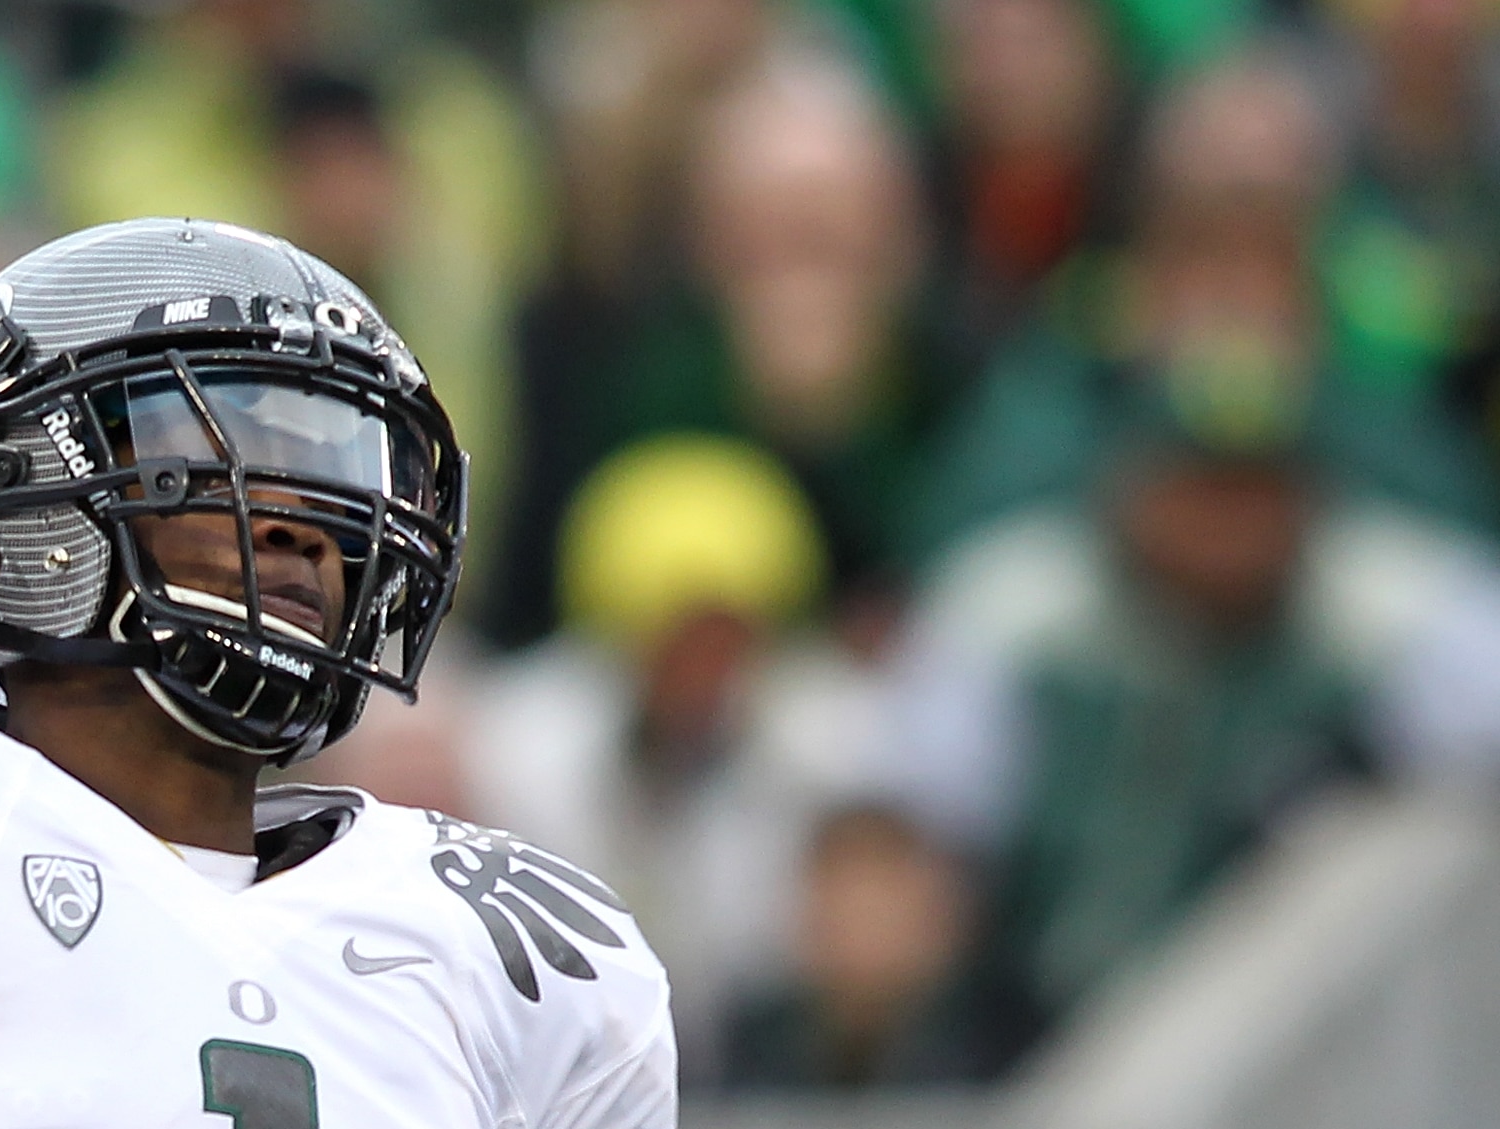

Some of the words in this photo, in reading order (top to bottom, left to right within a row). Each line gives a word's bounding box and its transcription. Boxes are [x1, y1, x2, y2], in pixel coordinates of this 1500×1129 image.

[163, 297, 211, 326] NIKE
[41, 406, 113, 511] Riddll
[259, 644, 315, 681] Riddell
[26, 857, 100, 914] PAC
[46, 892, 91, 928] 10
[228, 979, 277, 1025] O
